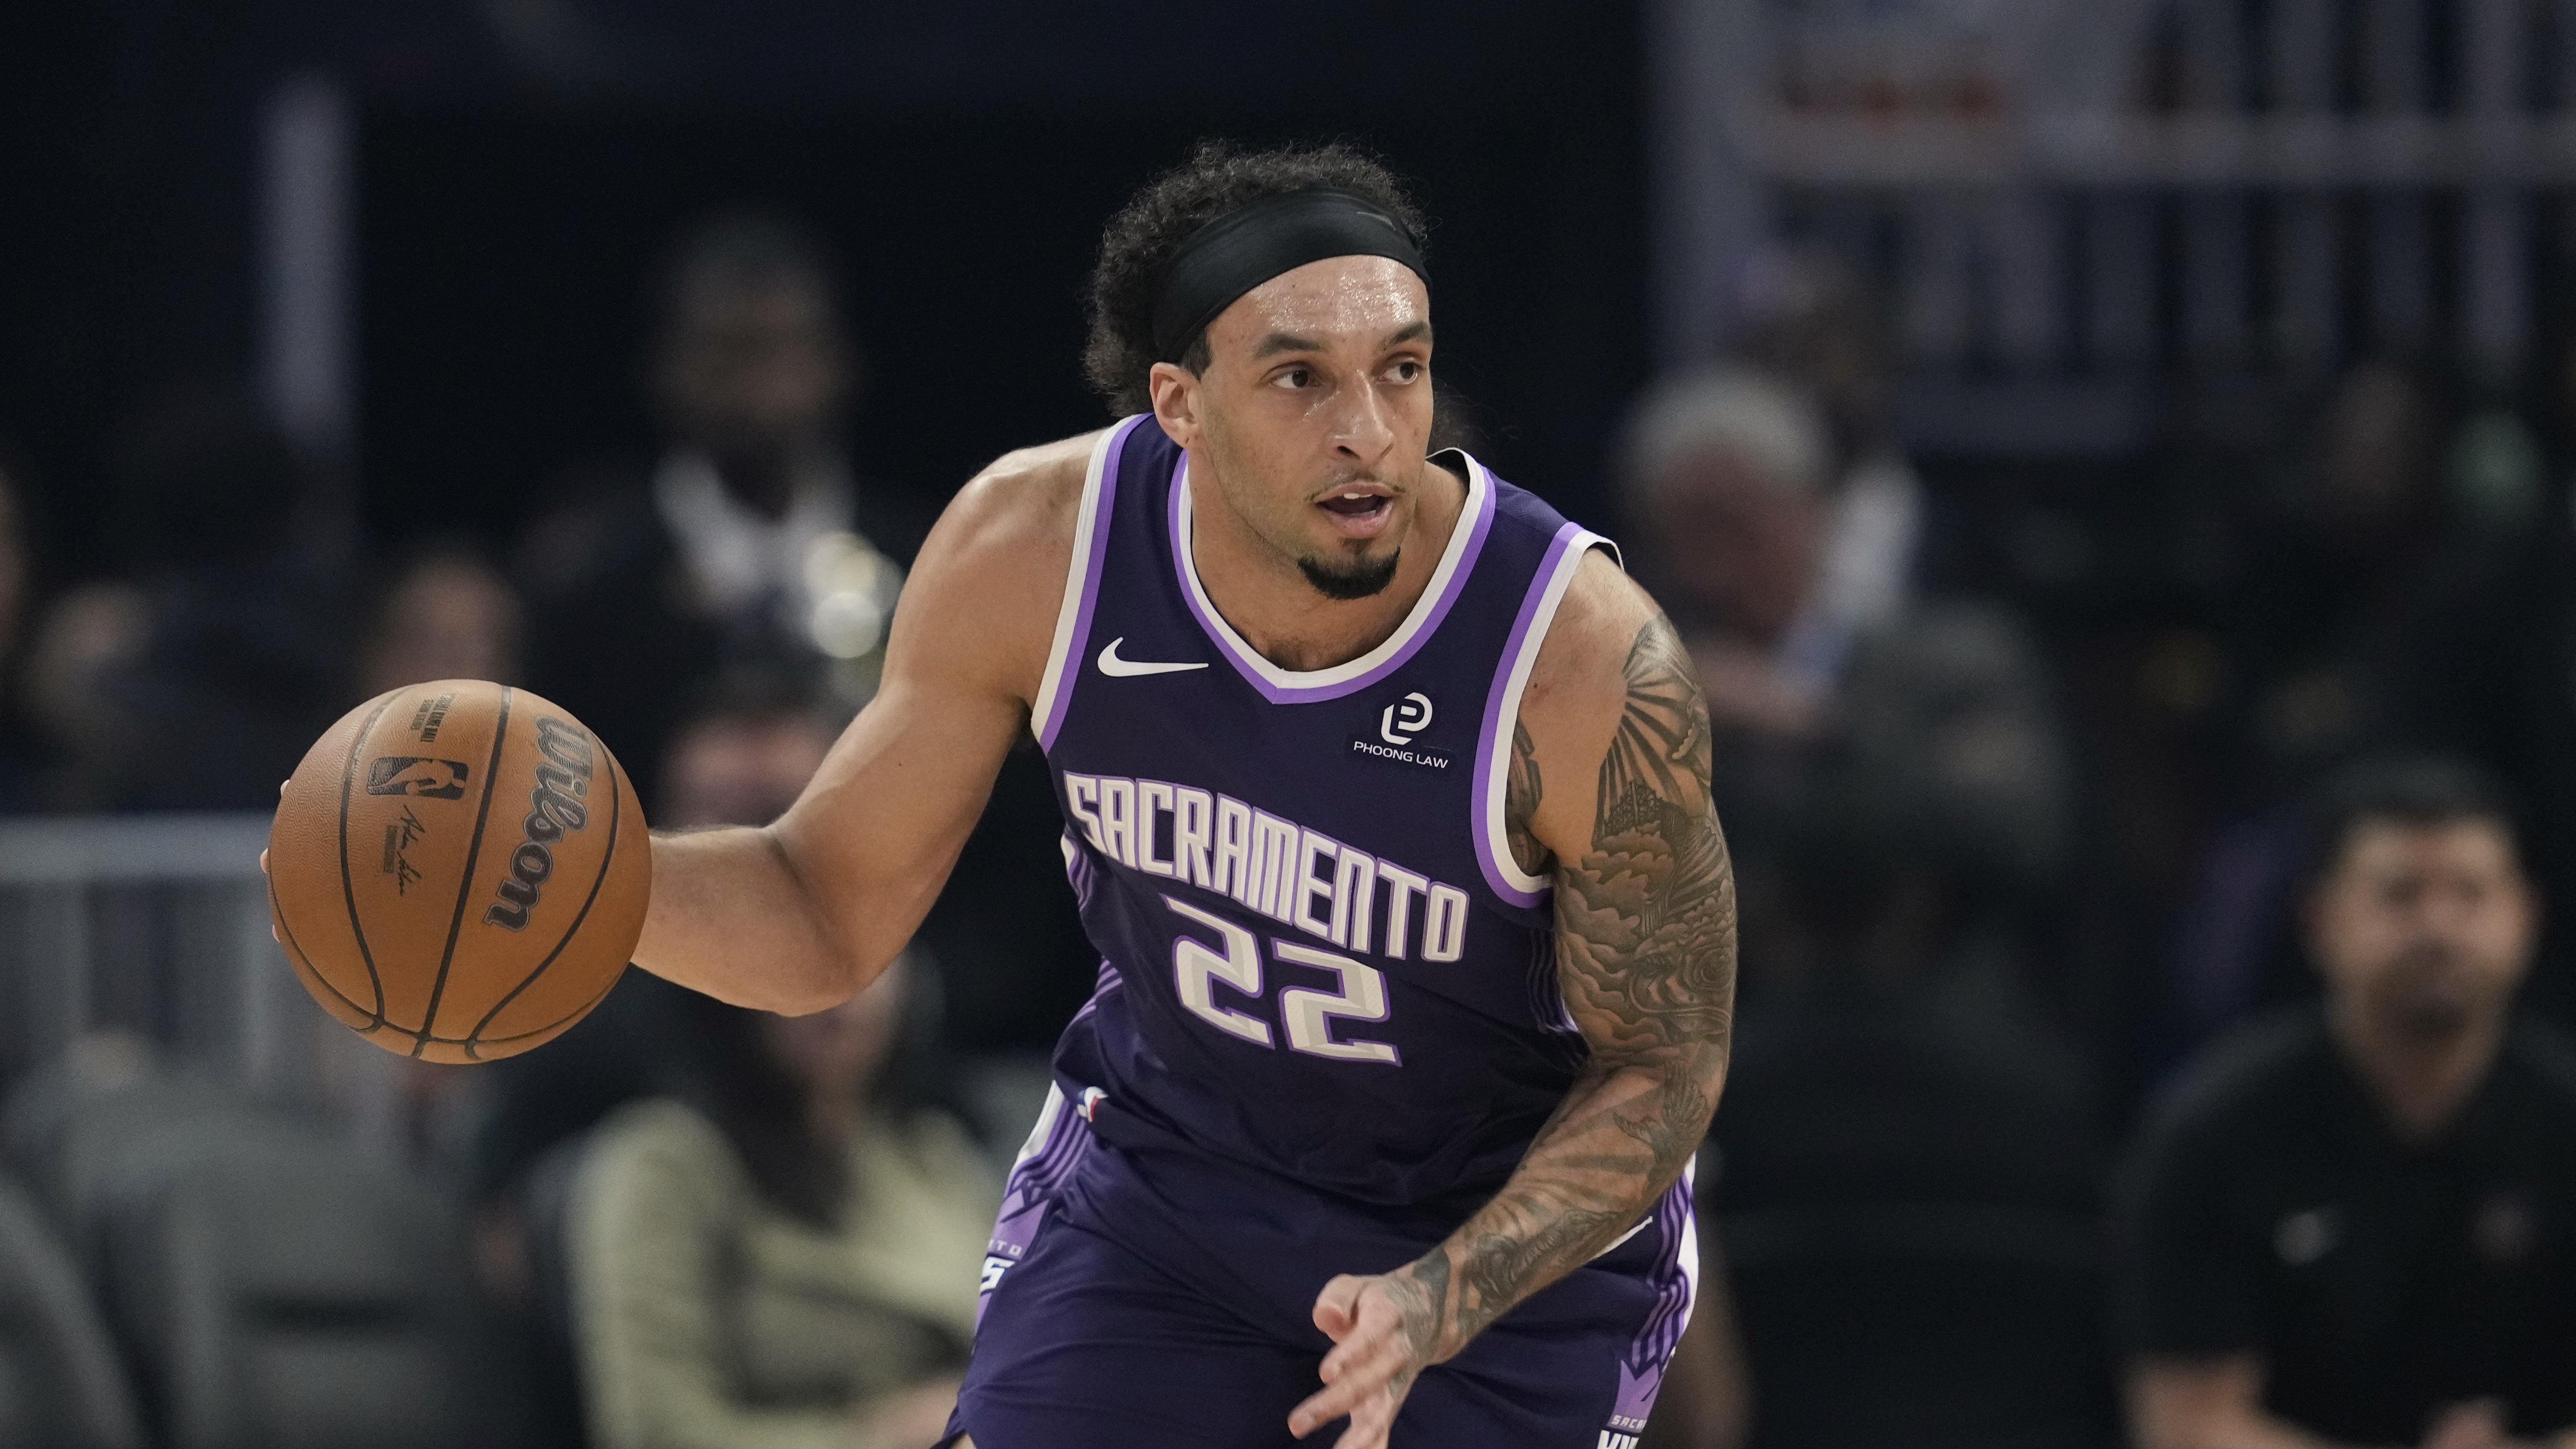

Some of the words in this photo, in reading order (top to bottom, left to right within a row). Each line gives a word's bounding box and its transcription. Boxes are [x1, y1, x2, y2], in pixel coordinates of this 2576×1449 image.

[483, 715, 593, 931] Wilson
[1353, 741, 1413, 762] PHOONG
[1416, 754, 1448, 769] LAW
[1063, 770, 1469, 962] SACRAMENTO
[1162, 894, 1402, 1067] 22
